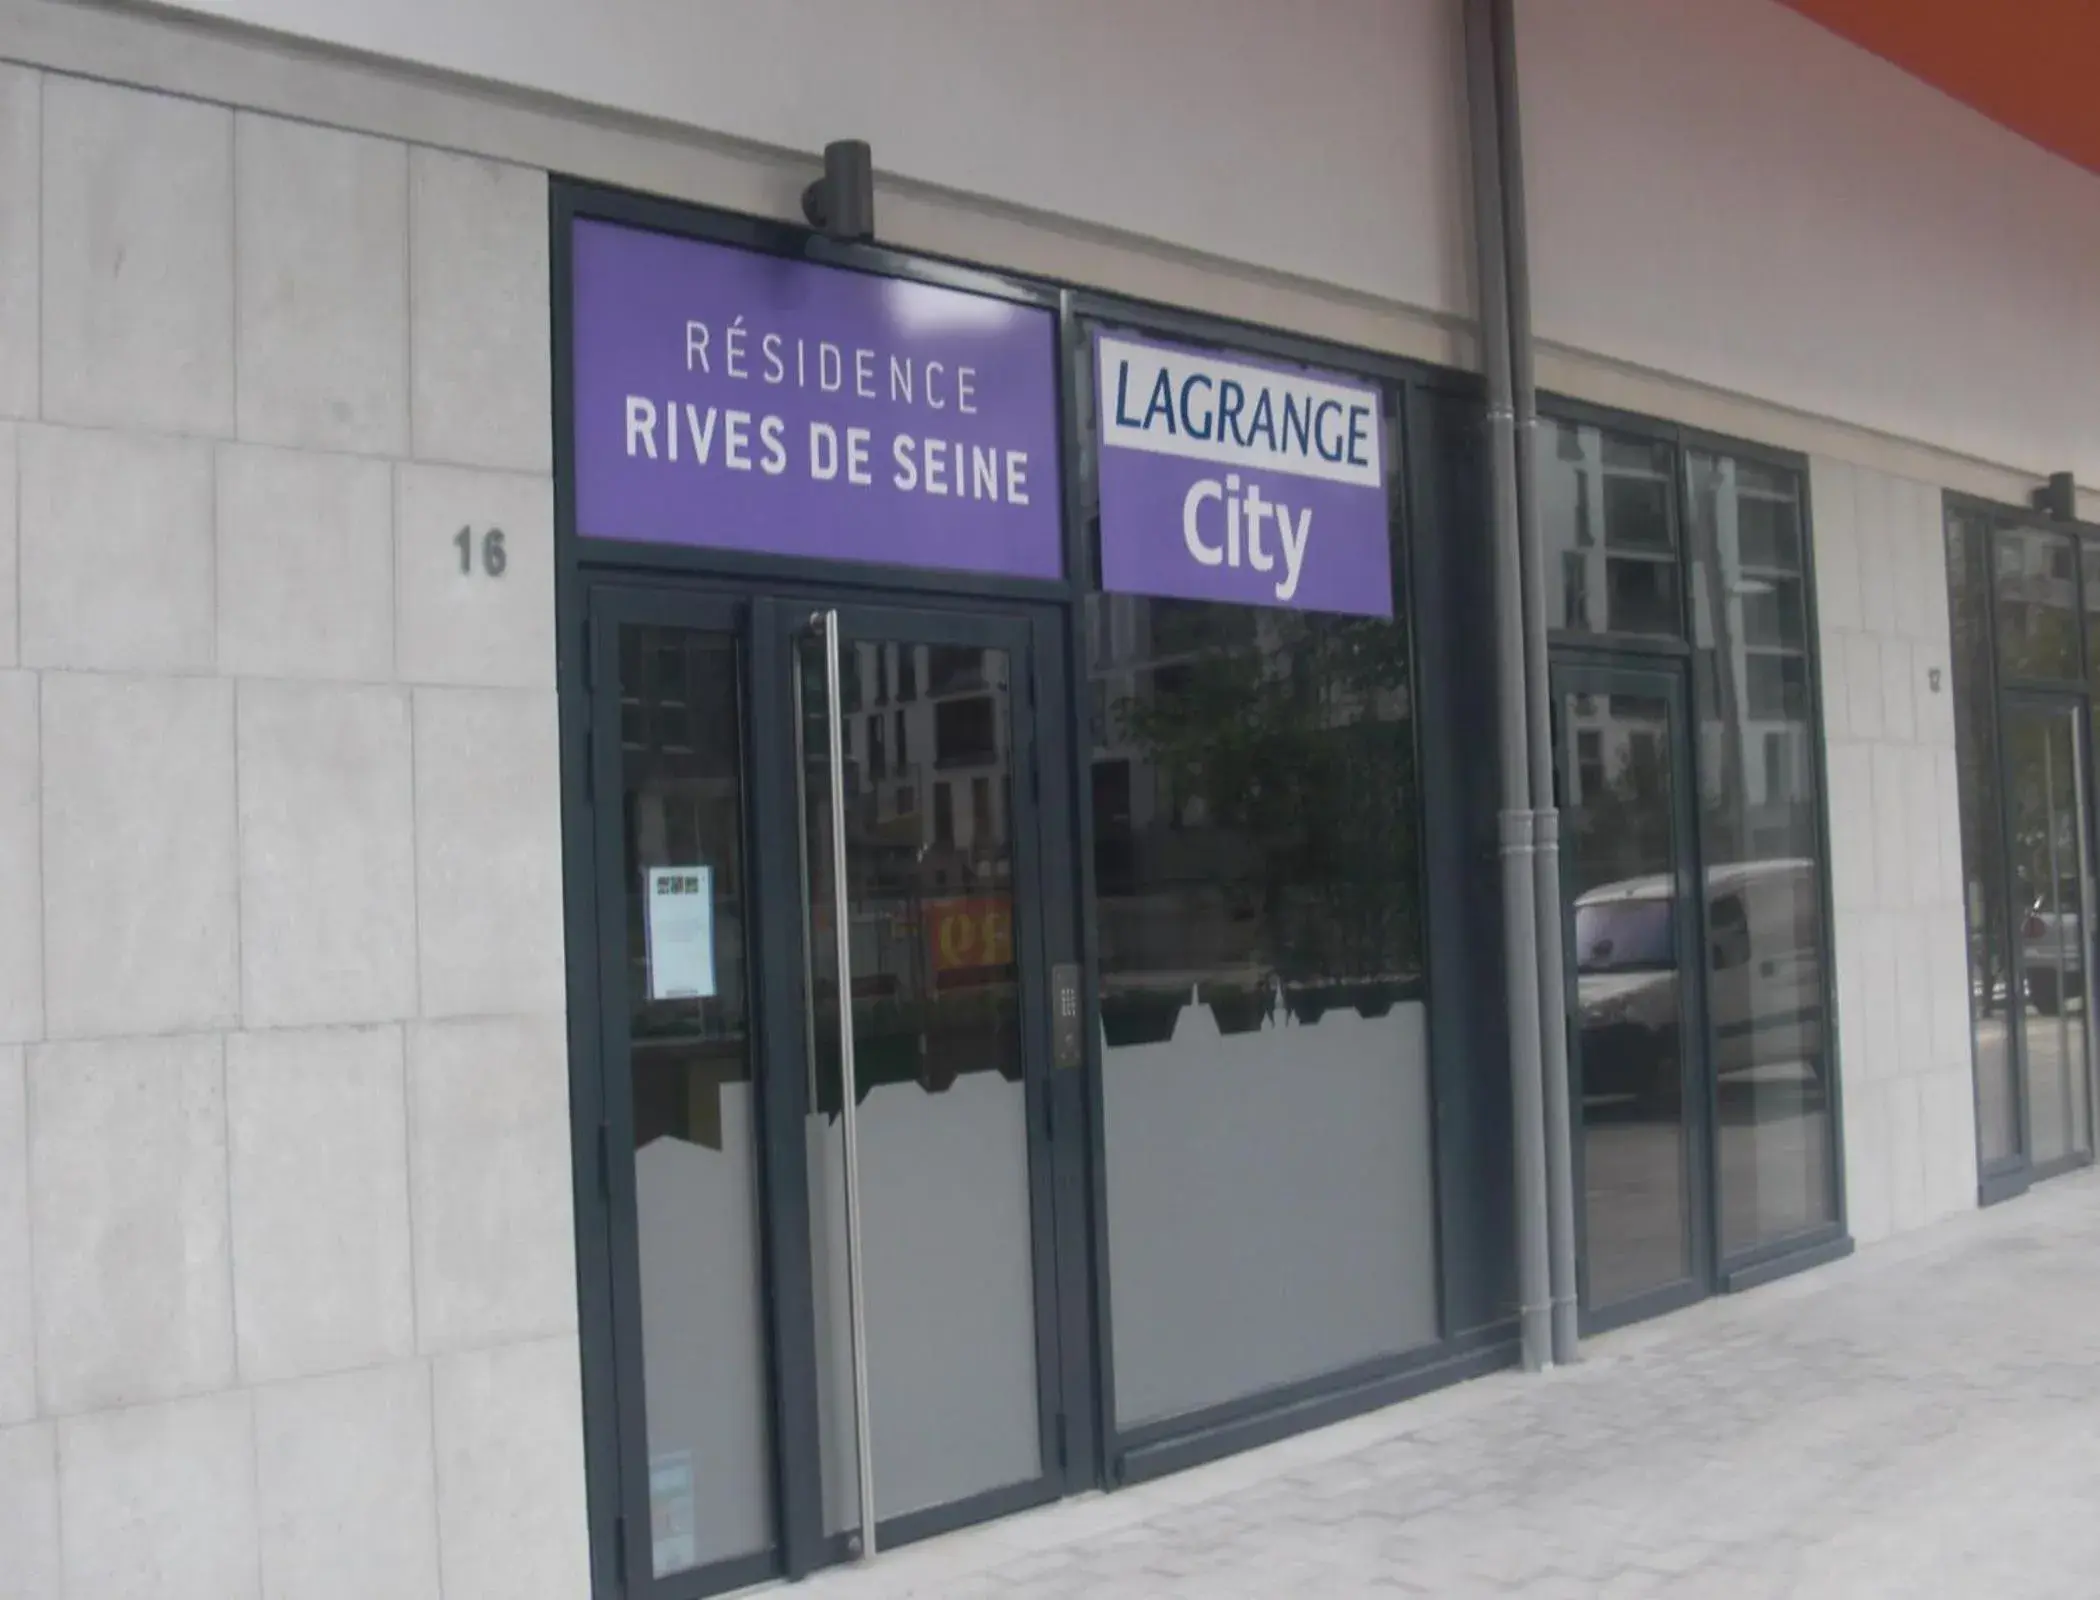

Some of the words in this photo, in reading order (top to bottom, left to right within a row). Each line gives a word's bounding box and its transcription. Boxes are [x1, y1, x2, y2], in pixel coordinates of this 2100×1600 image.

[686, 315, 978, 415] RÉSIDENCE
[1115, 360, 1371, 467] LAGRANGE
[625, 395, 788, 475] RIVES
[809, 422, 873, 486] DE
[892, 433, 1030, 505] SEINE
[453, 525, 507, 578] 16
[1182, 474, 1313, 600] City
